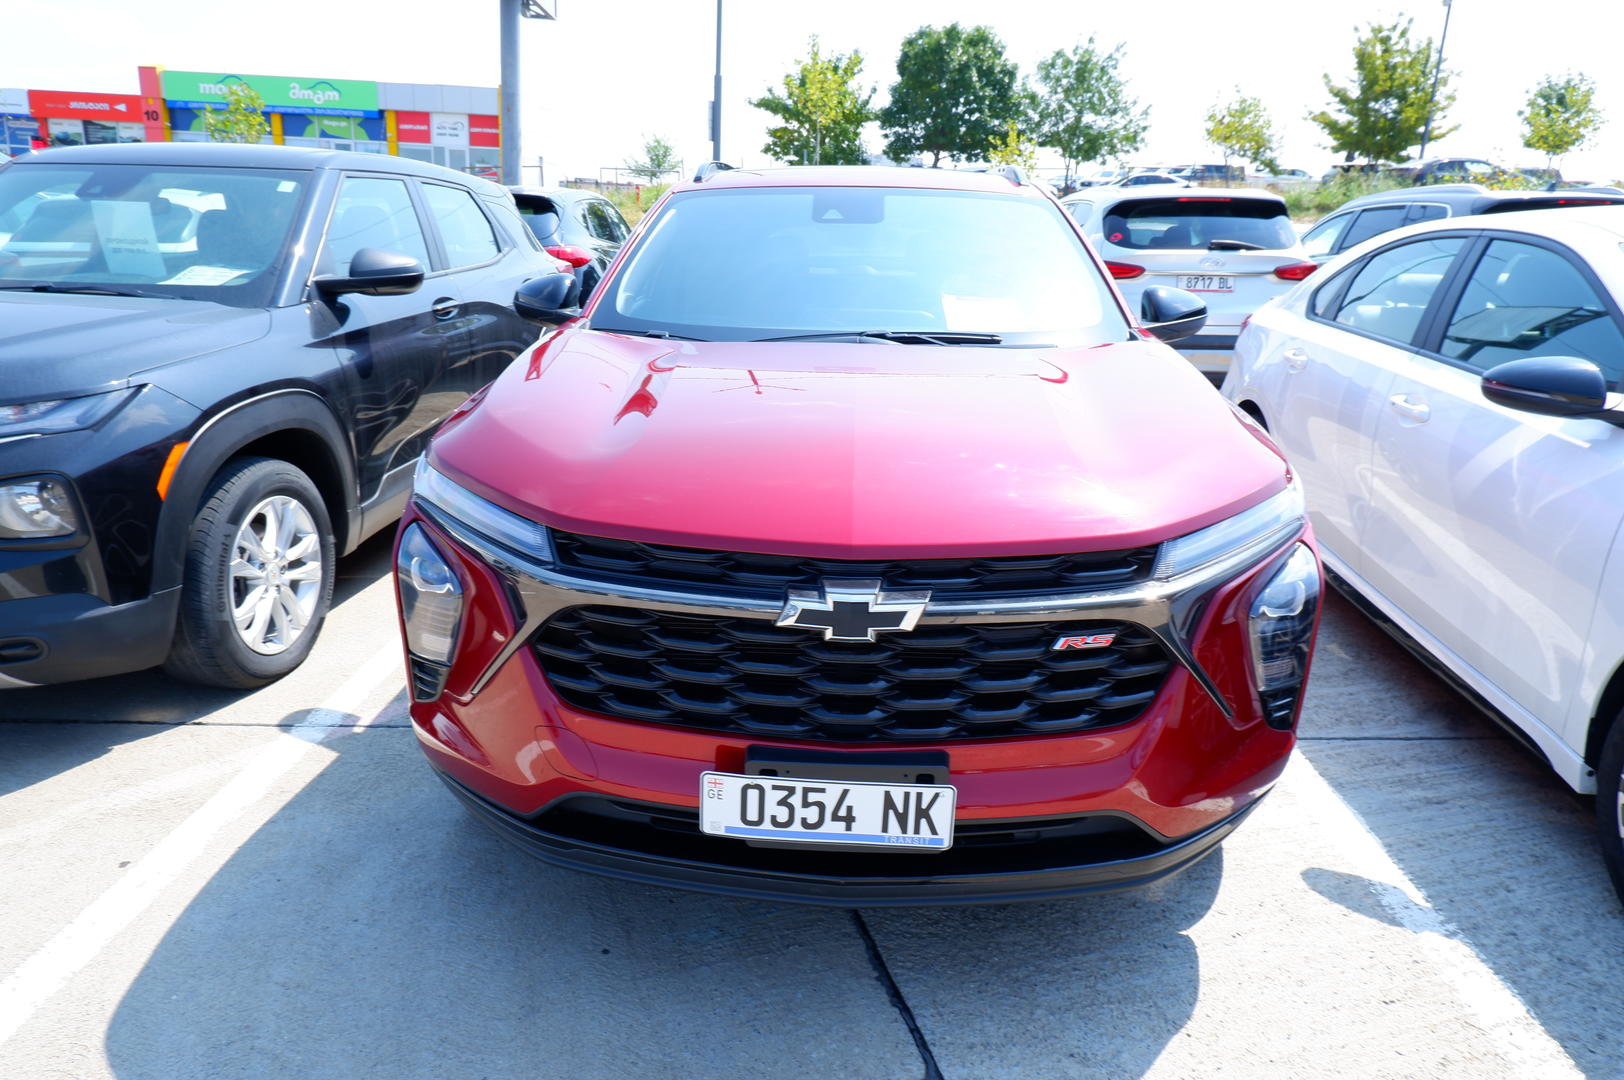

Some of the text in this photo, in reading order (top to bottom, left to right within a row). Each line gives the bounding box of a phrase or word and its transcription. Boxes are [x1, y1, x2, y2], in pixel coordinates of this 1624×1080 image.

[144, 110, 159, 121] 10
[1186, 277, 1233, 289] 8717 BL
[1052, 633, 1117, 650] RS
[707, 788, 724, 800] GE
[740, 782, 940, 836] 0354 NK
[883, 834, 932, 846] TRANSIT
